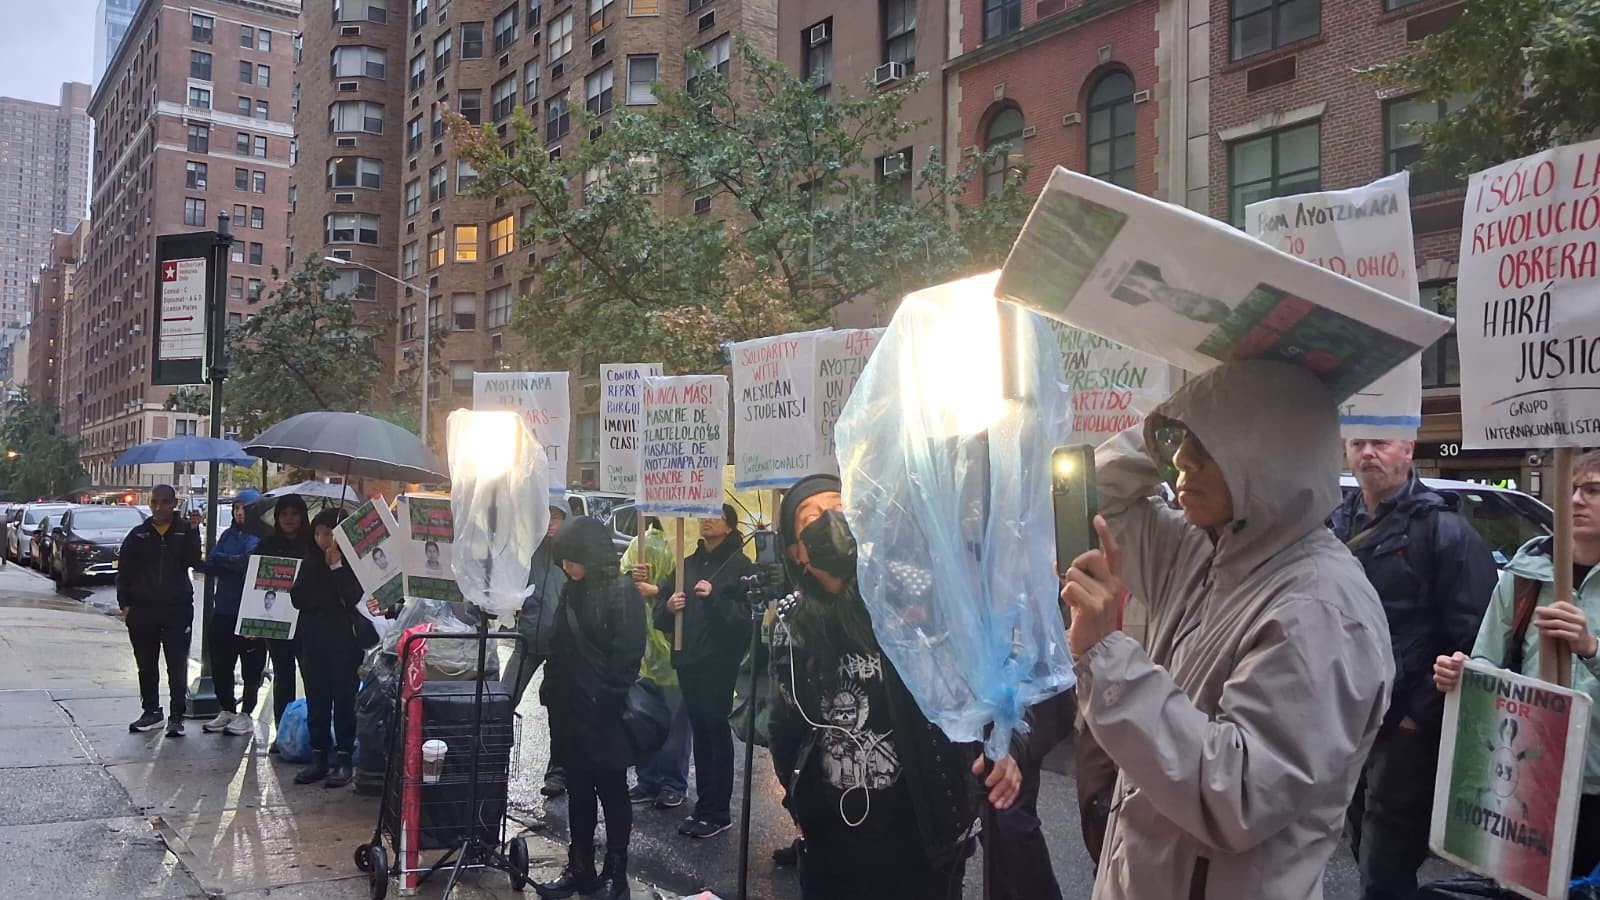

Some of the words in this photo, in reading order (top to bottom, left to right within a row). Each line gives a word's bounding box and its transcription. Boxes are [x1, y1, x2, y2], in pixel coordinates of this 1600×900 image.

[1471, 188, 1600, 256] REVOLUCIÓ
[1498, 240, 1597, 289] OBRERA
[1483, 280, 1552, 338] HARÁ
[741, 341, 798, 367] SOLIDARITY
[753, 362, 779, 381] WITH
[485, 377, 552, 392] AYOTZINAPA
[608, 383, 640, 397] REPRE
[682, 381, 712, 405] MÁS!
[743, 380, 792, 402] MEXICAN
[646, 408, 687, 426] MASACRE
[694, 408, 707, 423] DE
[744, 396, 806, 422] STUDENTS!
[1509, 400, 1549, 417] GRUPO
[644, 442, 684, 457] MASACRE
[692, 442, 707, 455] DE
[1440, 444, 1459, 456] 30
[644, 471, 684, 486] MASACRE
[691, 469, 705, 483] DE
[1467, 672, 1568, 714] RUNNING
[1495, 698, 1531, 718] FOR
[1454, 799, 1549, 857] AYOTZINAPA
